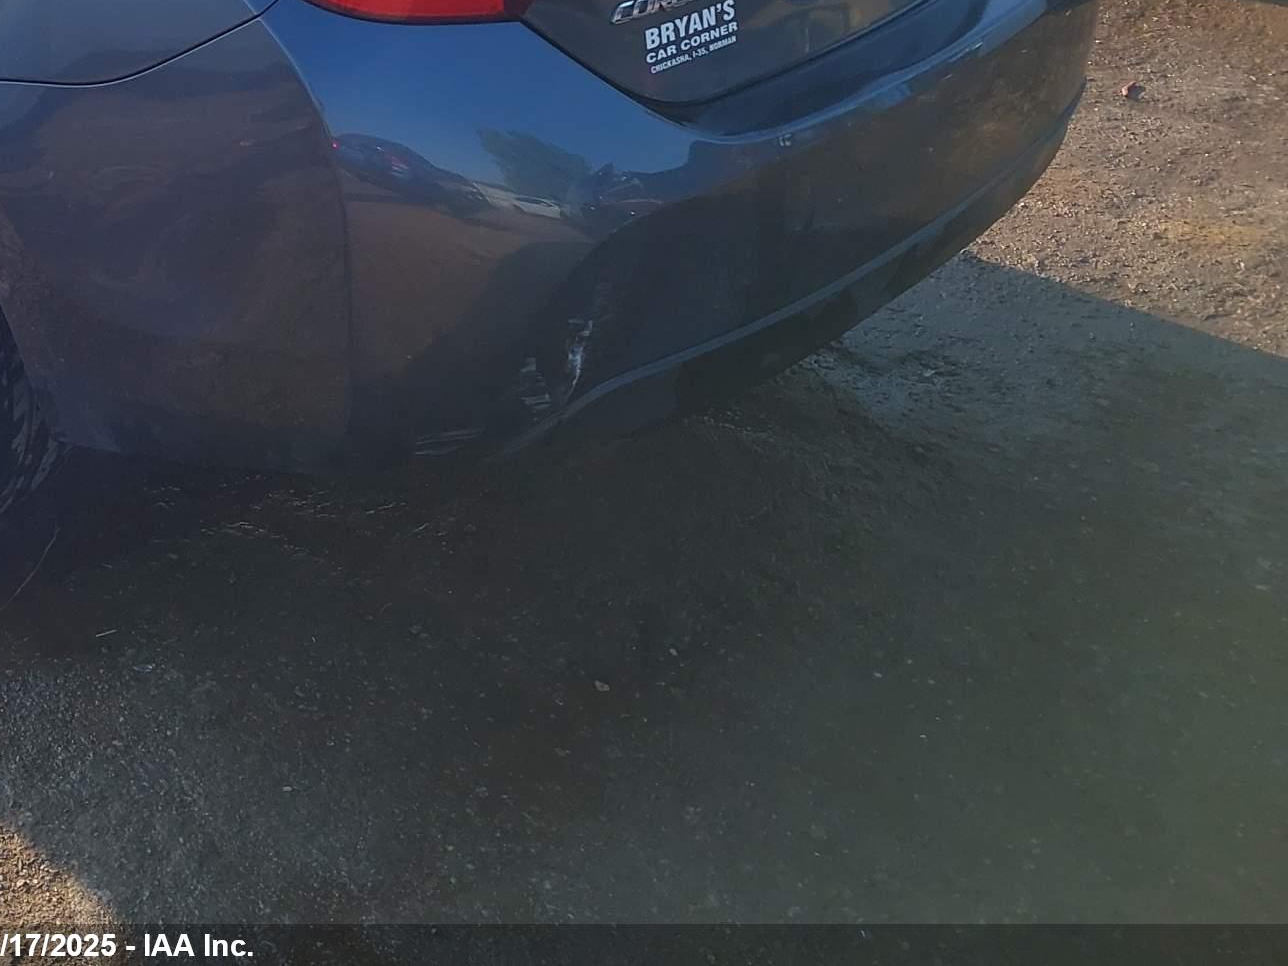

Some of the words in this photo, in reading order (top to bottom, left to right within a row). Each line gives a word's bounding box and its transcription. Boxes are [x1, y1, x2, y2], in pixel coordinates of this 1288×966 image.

[645, 0, 736, 50] BRYAN'S
[646, 44, 677, 64] CAR
[681, 21, 738, 51] CORNER
[709, 35, 737, 52] NORMAN
